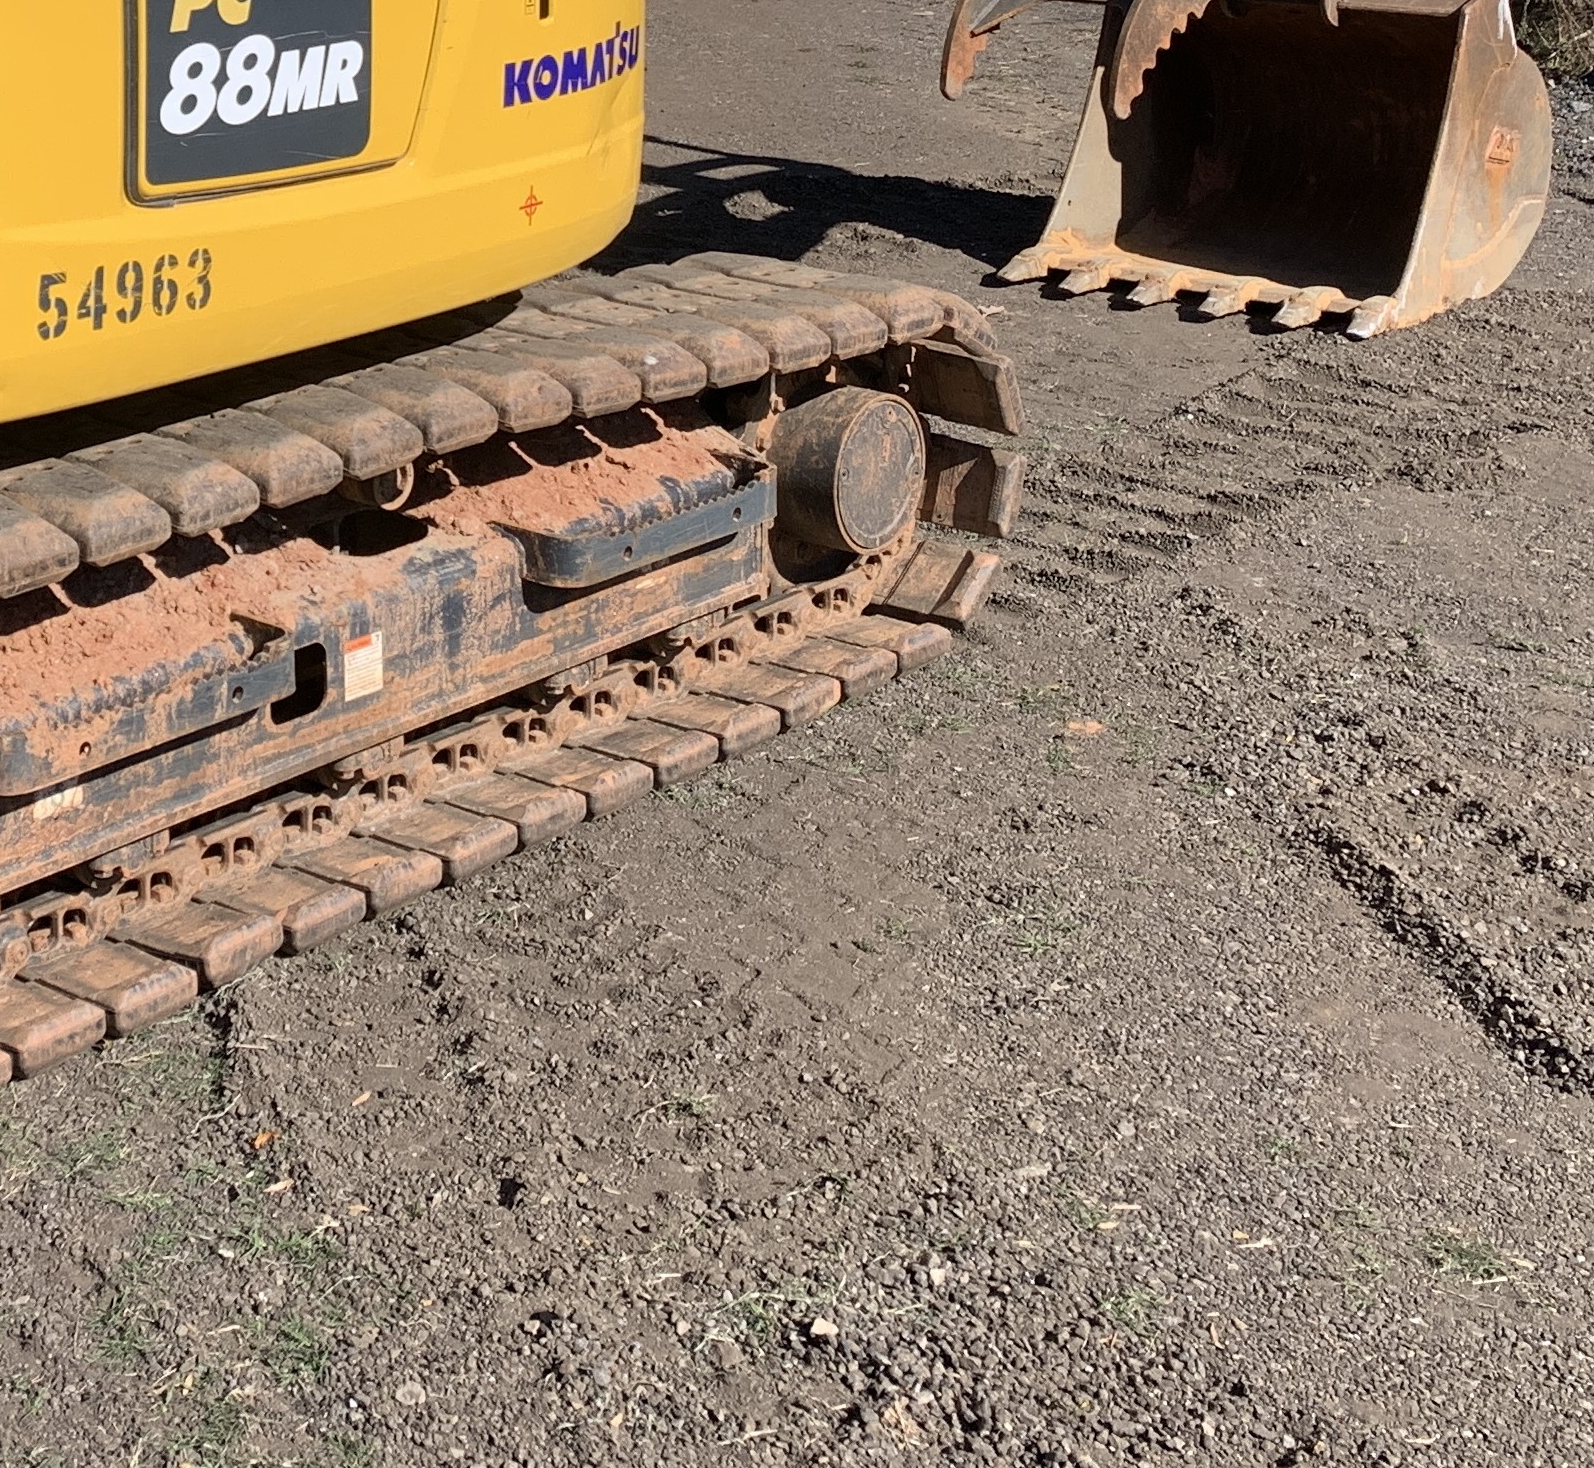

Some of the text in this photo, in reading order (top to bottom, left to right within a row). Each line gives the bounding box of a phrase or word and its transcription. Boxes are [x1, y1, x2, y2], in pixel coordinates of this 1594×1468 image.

[160, 34, 364, 136] 88MR
[503, 20, 640, 109] KOMATSU
[37, 247, 213, 342] 54963
